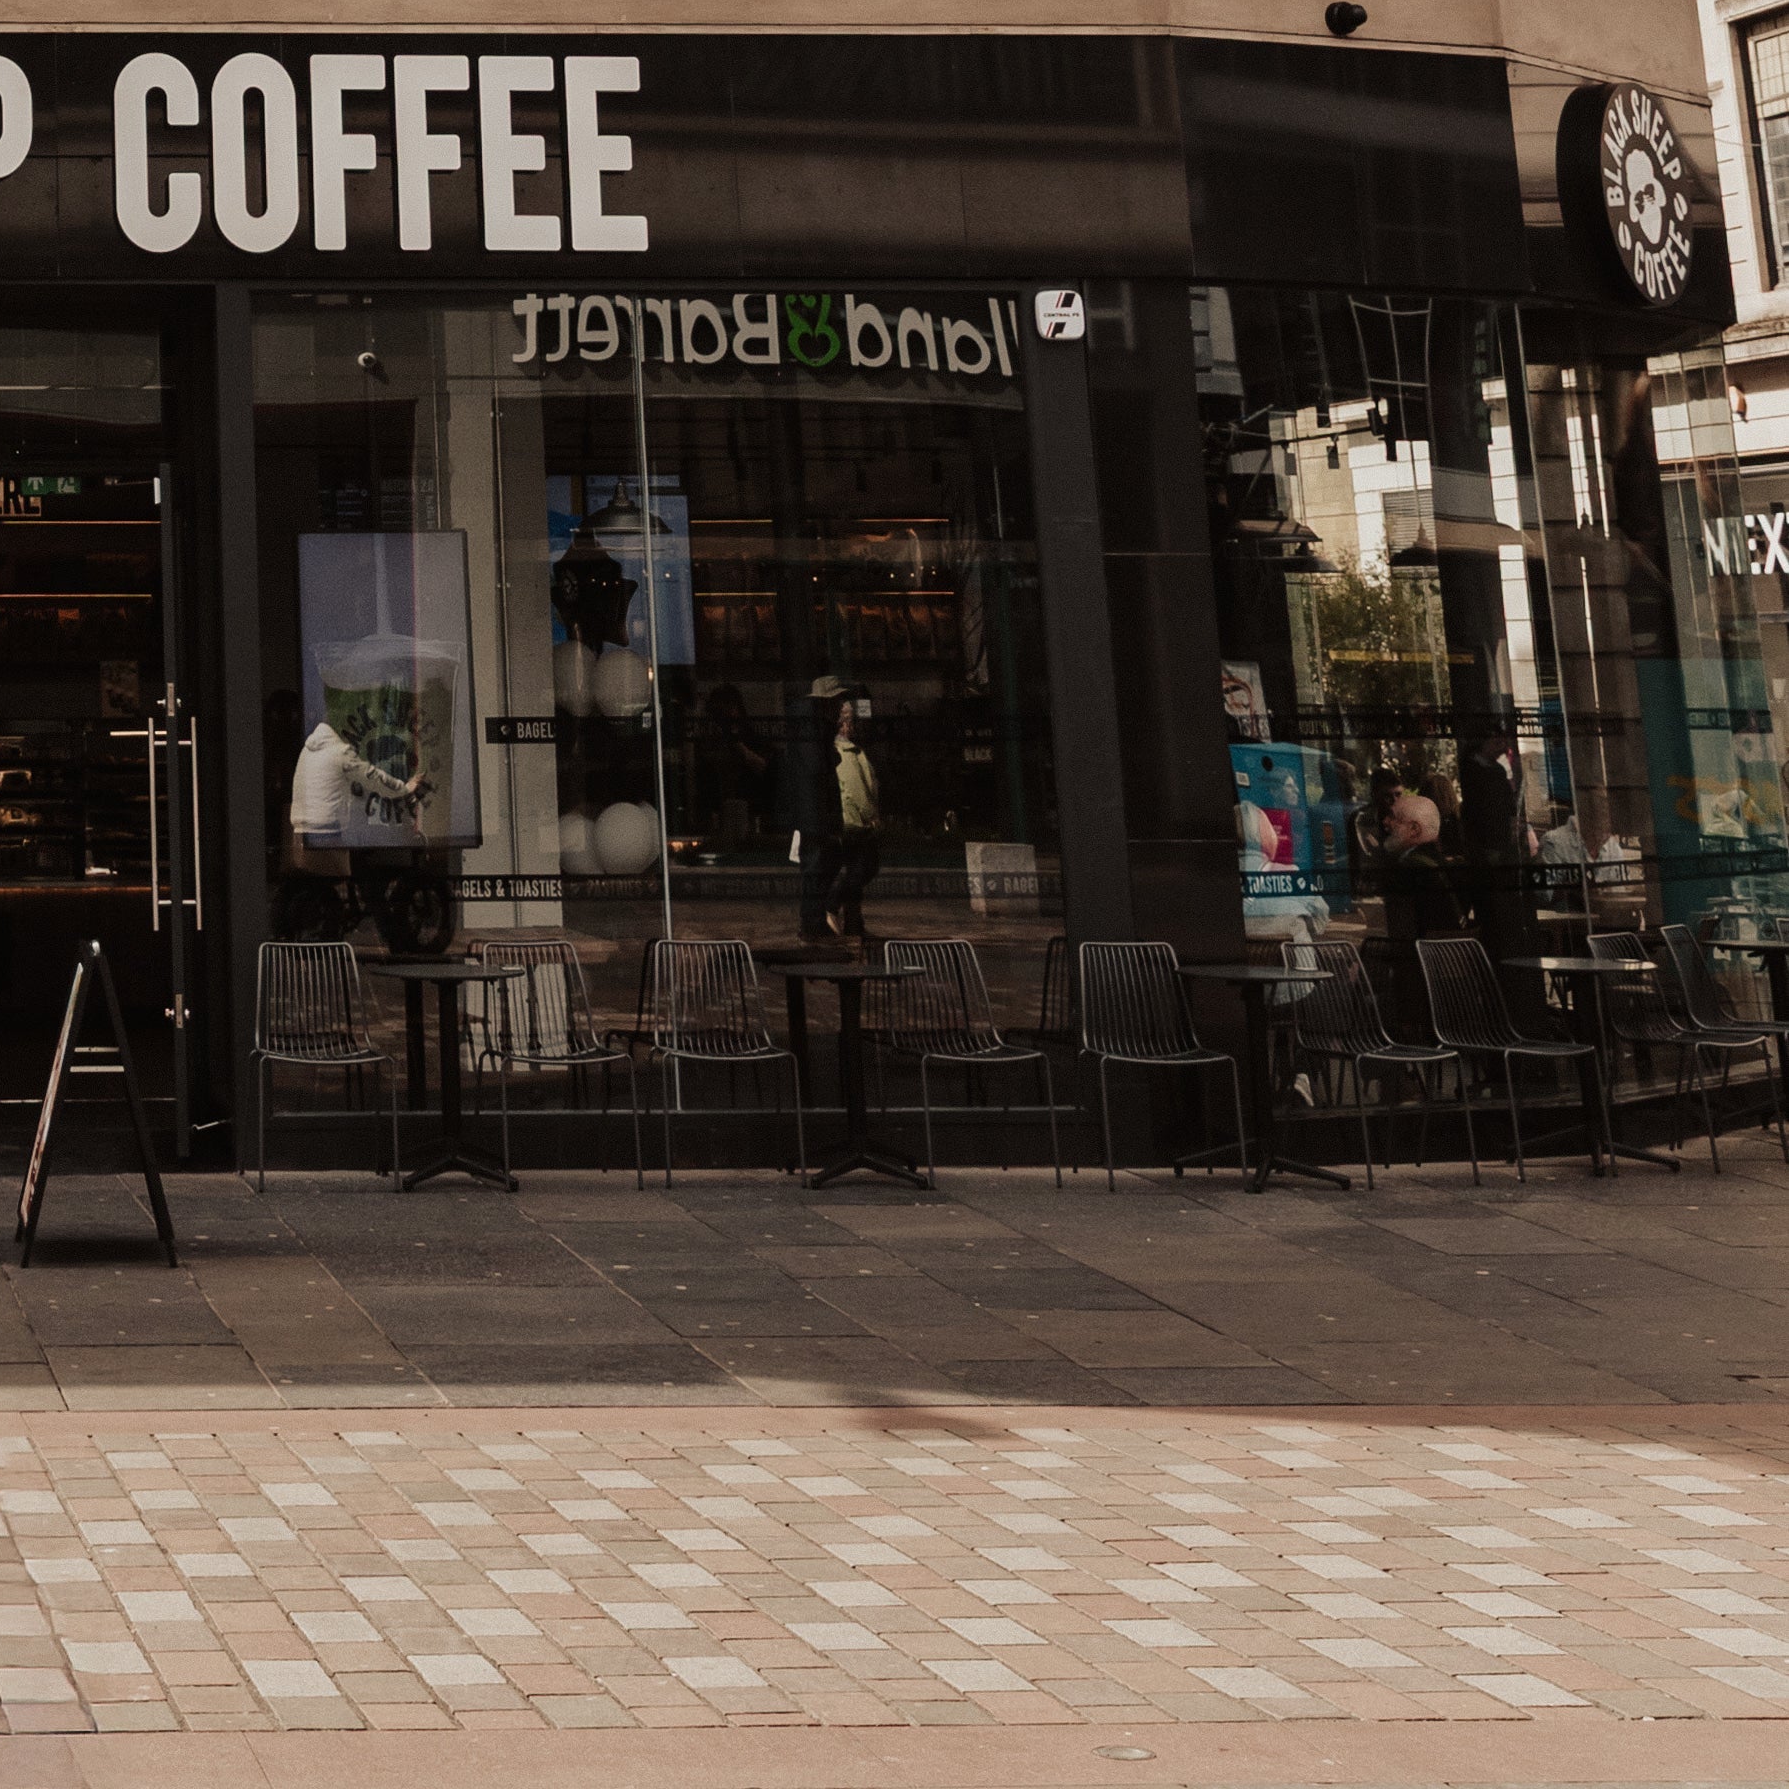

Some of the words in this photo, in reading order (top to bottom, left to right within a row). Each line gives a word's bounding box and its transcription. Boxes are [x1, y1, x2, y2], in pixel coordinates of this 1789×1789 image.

[113, 52, 648, 253] COFFEE
[1603, 93, 1633, 207] BLACK
[1630, 89, 1682, 180] SHEEP
[1634, 219, 1690, 300] COFFEE
[516, 722, 556, 739] BAGEL
[496, 880, 505, 898] &
[508, 880, 562, 898] TOASTIES
[1247, 874, 1294, 893] TOASTIES
